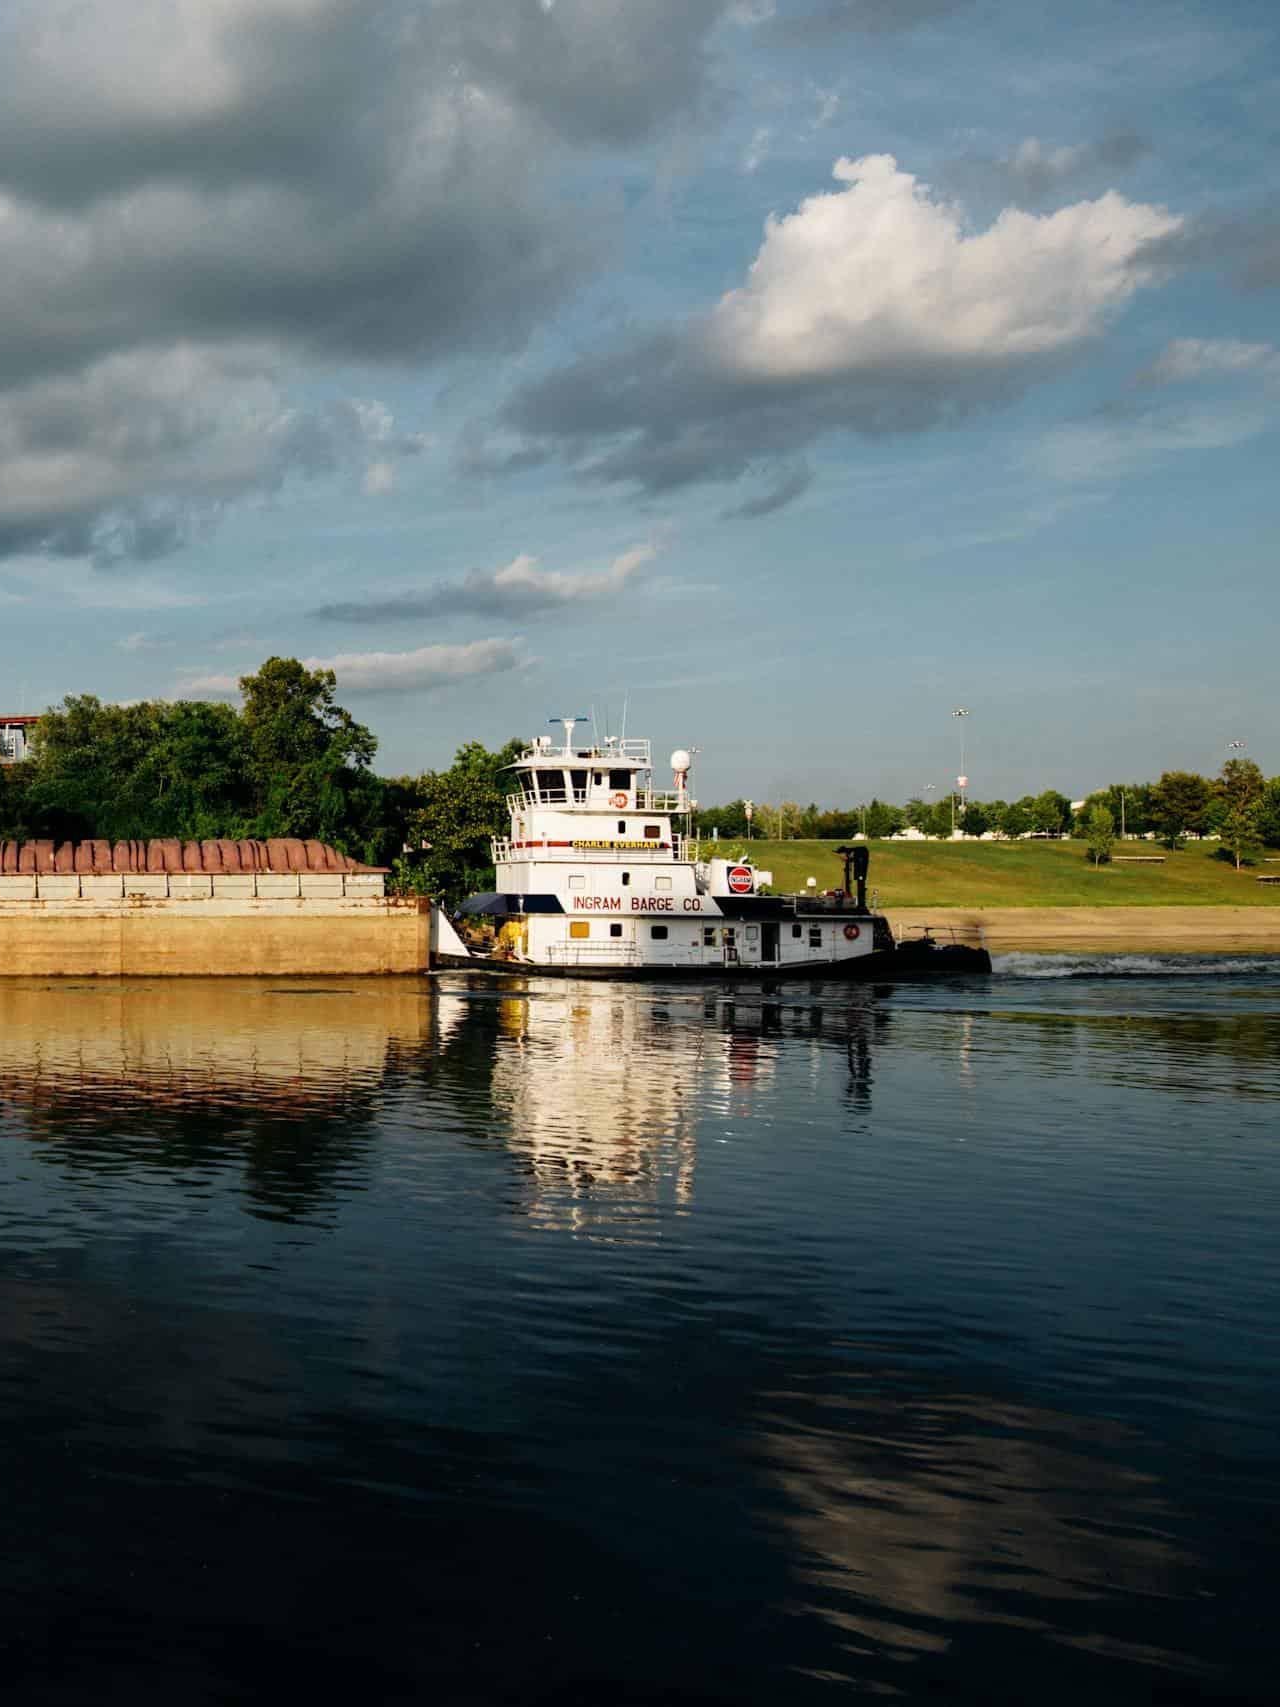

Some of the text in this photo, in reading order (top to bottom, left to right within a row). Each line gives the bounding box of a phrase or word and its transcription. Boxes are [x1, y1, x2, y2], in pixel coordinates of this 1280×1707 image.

[573, 896, 704, 911] INGRAM BARGE CO.
